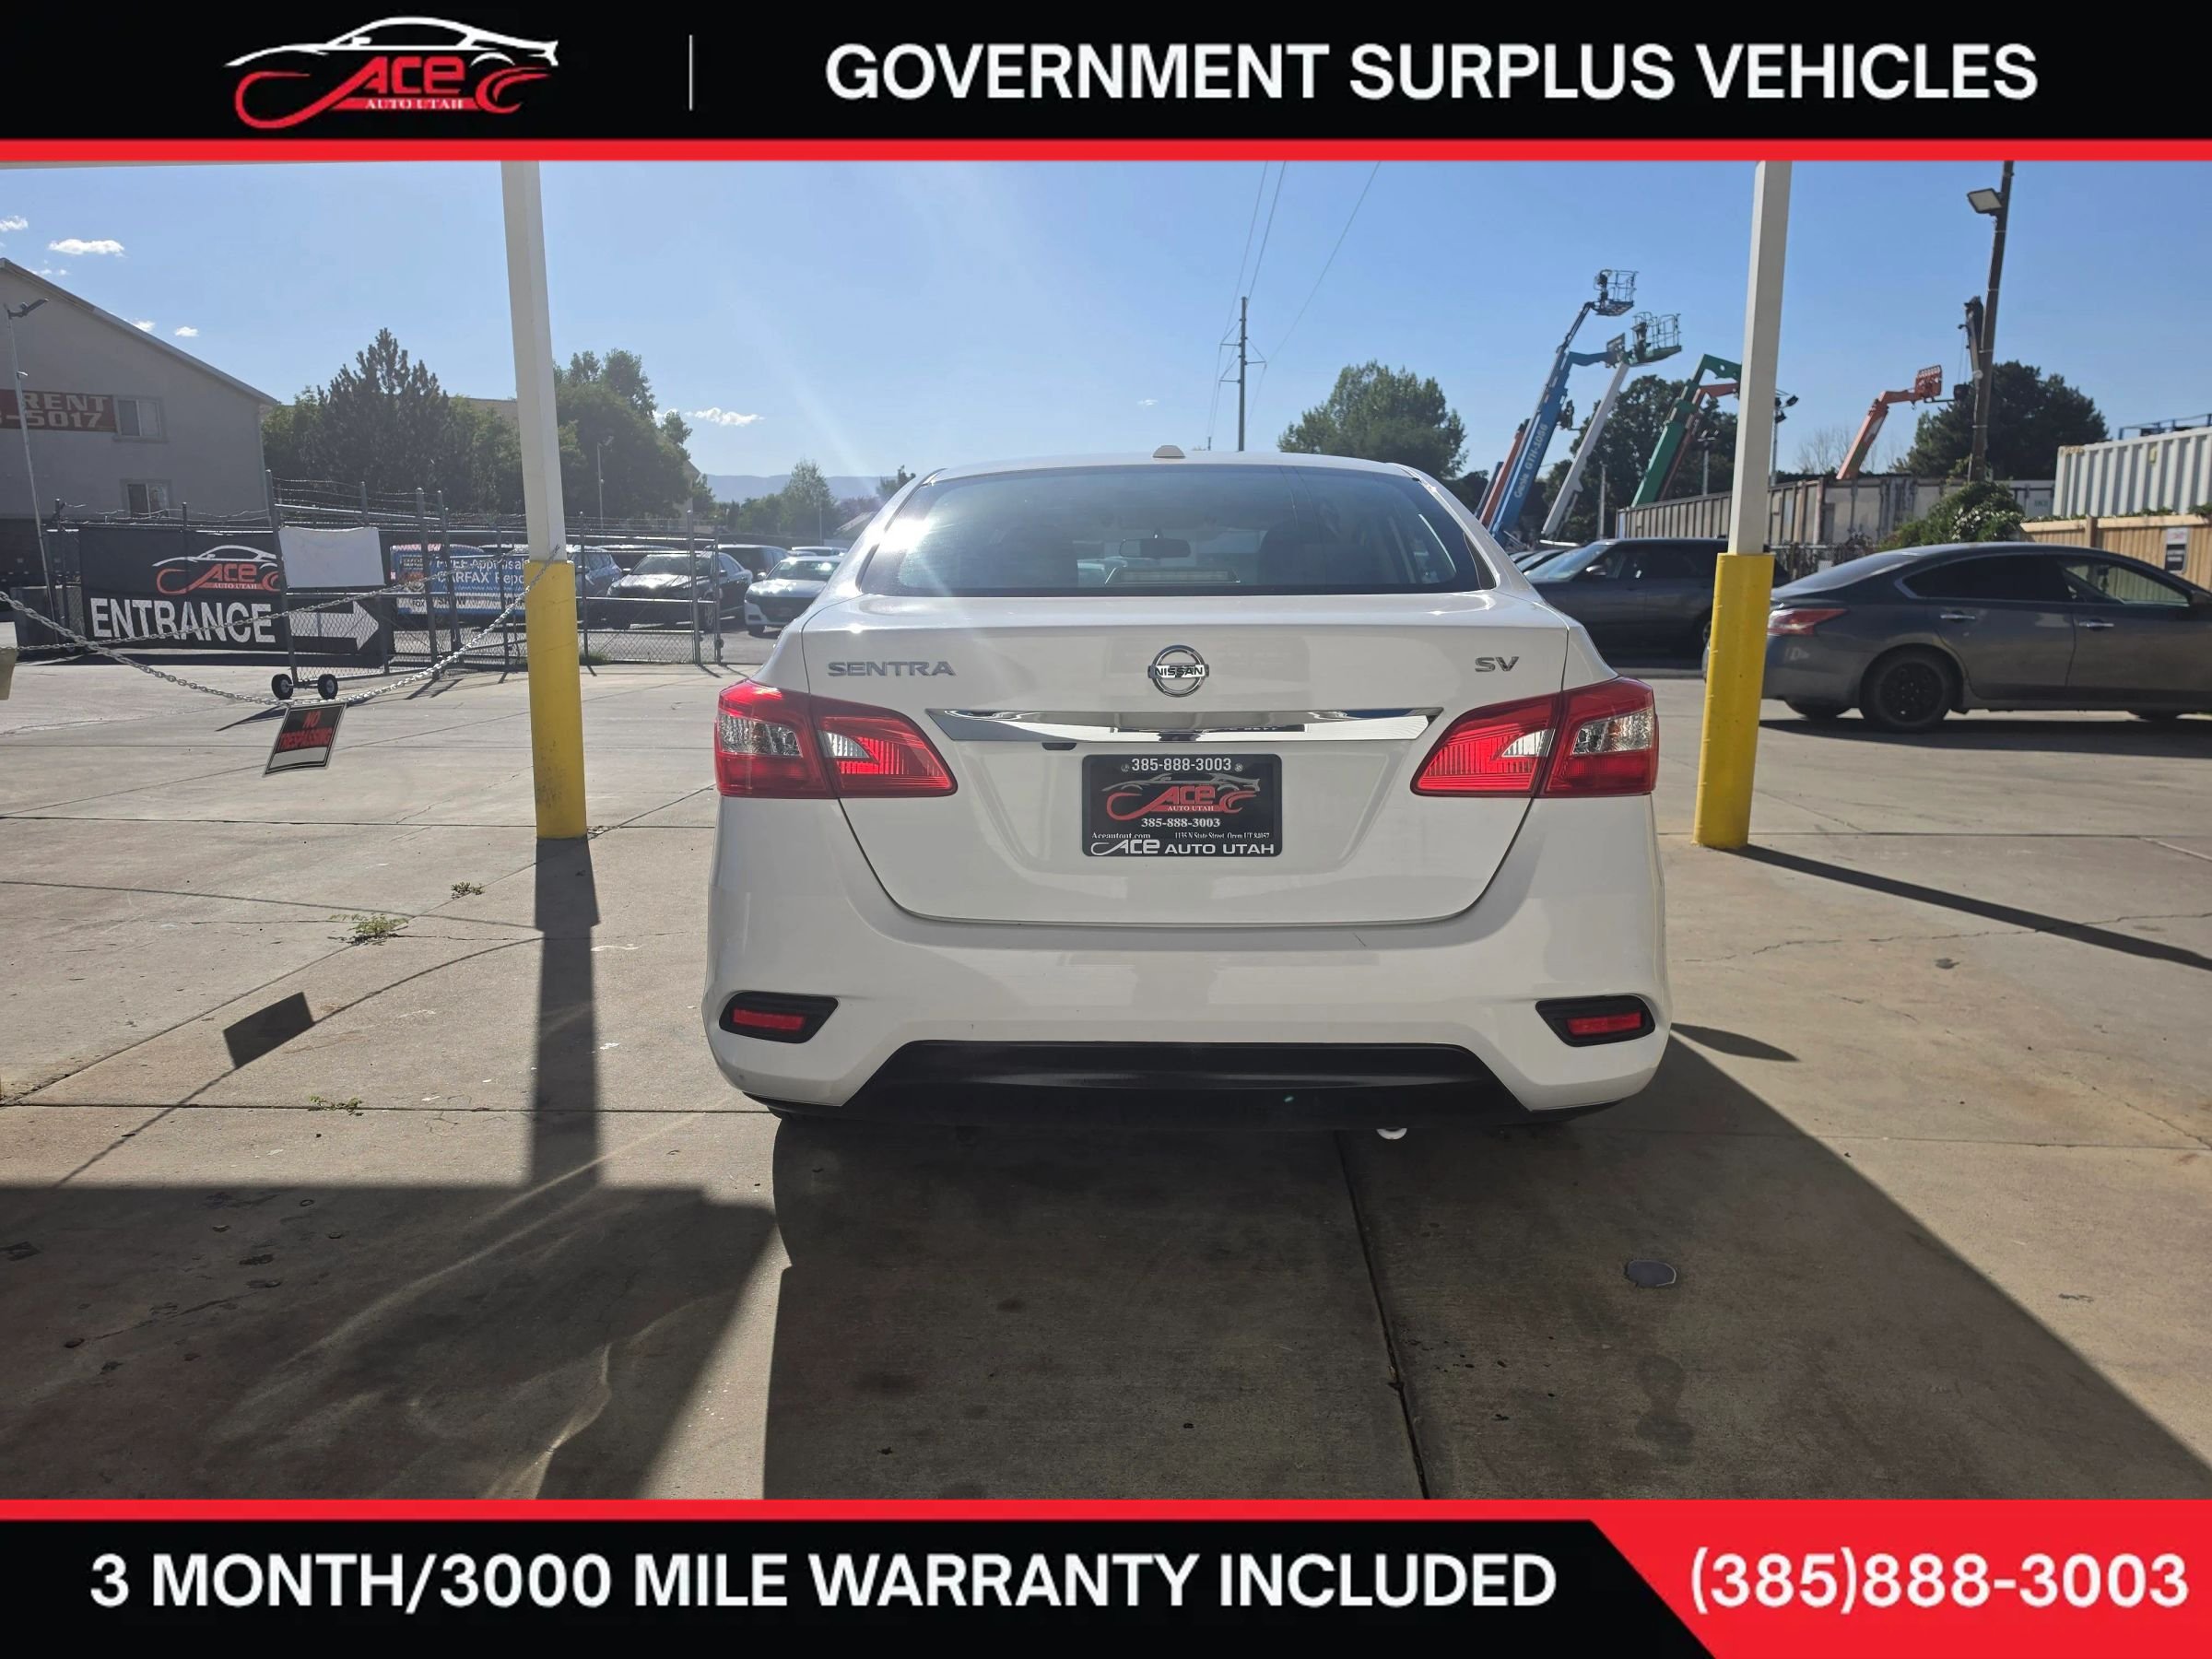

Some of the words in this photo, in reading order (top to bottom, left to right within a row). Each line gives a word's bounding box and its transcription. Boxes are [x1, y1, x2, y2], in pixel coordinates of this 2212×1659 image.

[22, 392, 110, 412] RENT
[0, 409, 102, 429] -5017
[90, 597, 276, 643] ENTRANCE
[827, 661, 957, 677] SENTRA
[1154, 666, 1203, 677] NISSAN
[1475, 655, 1519, 673] SV
[302, 710, 322, 727] NO
[1131, 758, 1231, 771] 385-888-3003
[1141, 818, 1220, 828] 385-888-3003
[1164, 843, 1216, 854] AUTO
[1222, 843, 1275, 854] UTAH
